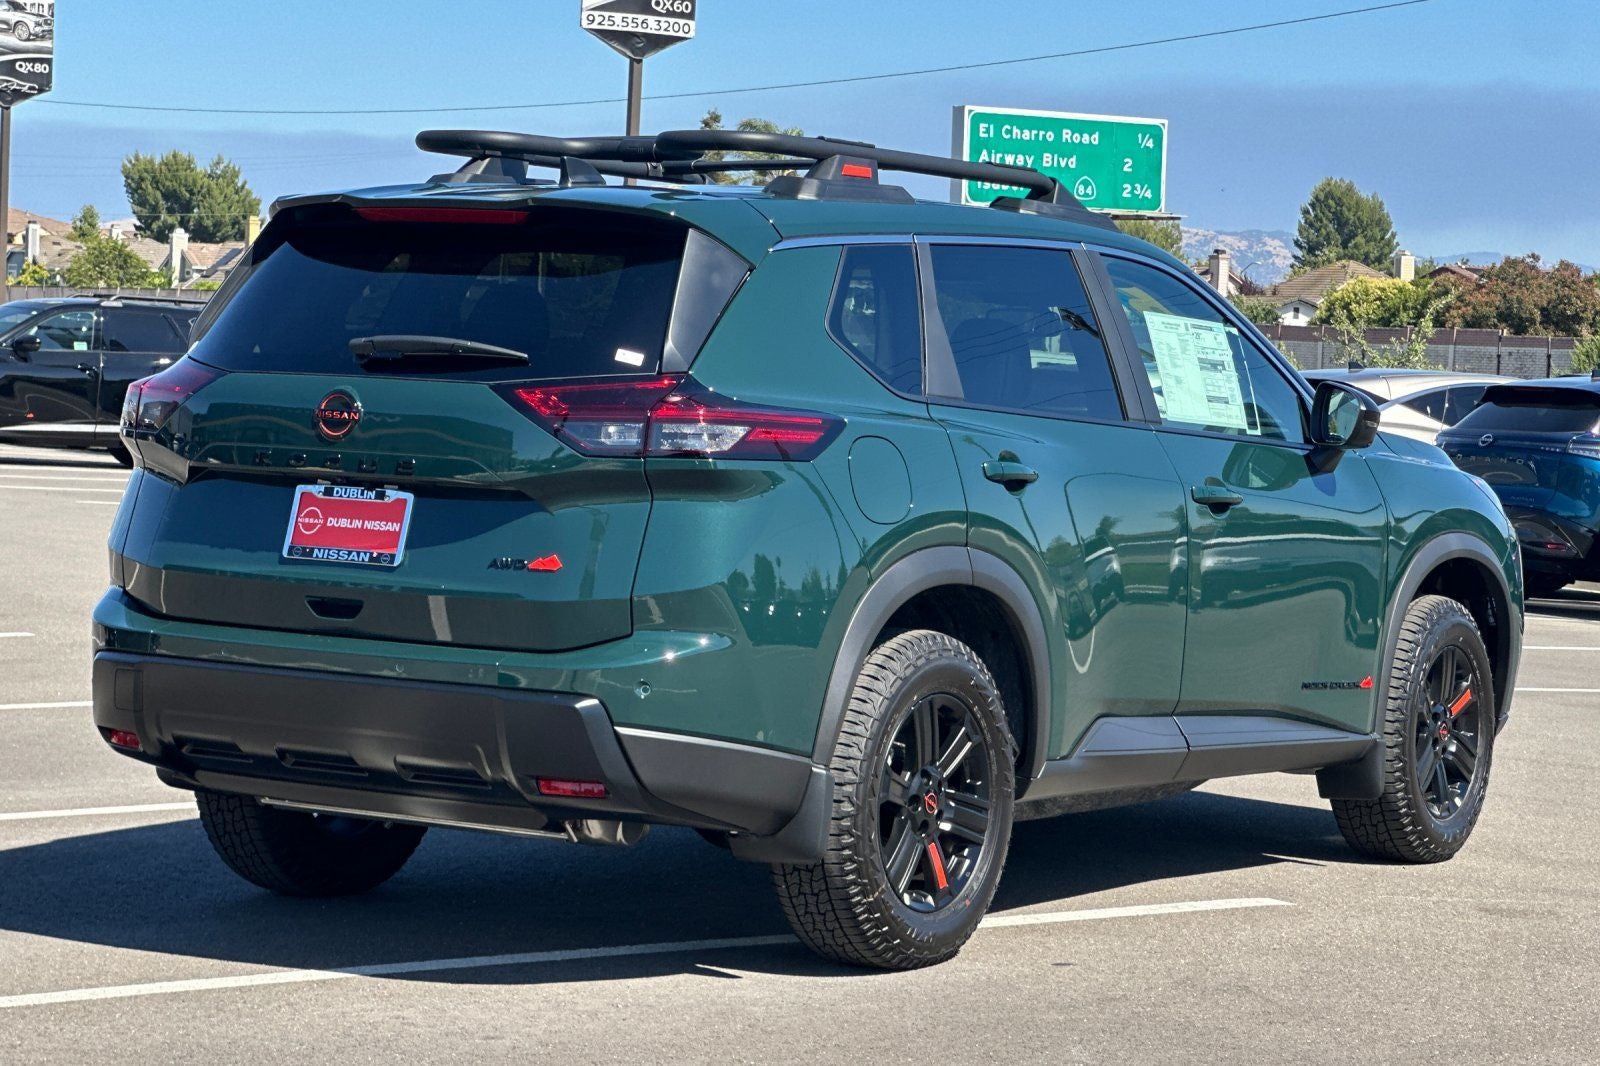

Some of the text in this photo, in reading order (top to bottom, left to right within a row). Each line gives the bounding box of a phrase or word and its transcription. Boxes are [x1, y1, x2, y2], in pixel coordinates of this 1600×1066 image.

[651, 0, 692, 13] QX60
[586, 13, 691, 35] 925.556.3200
[15, 61, 49, 74] QX80
[979, 123, 994, 138] El
[1001, 125, 1055, 141] Charro
[1062, 129, 1099, 145] Road
[978, 149, 1133, 172] Airway Blvd 2
[1078, 185, 1092, 196] 84
[316, 410, 359, 420] NISSAN
[333, 487, 376, 500] DUBLIN
[298, 516, 324, 524] NISSAN
[327, 517, 400, 532] DUBLIN NISSAN
[313, 548, 370, 562] NISSAN
